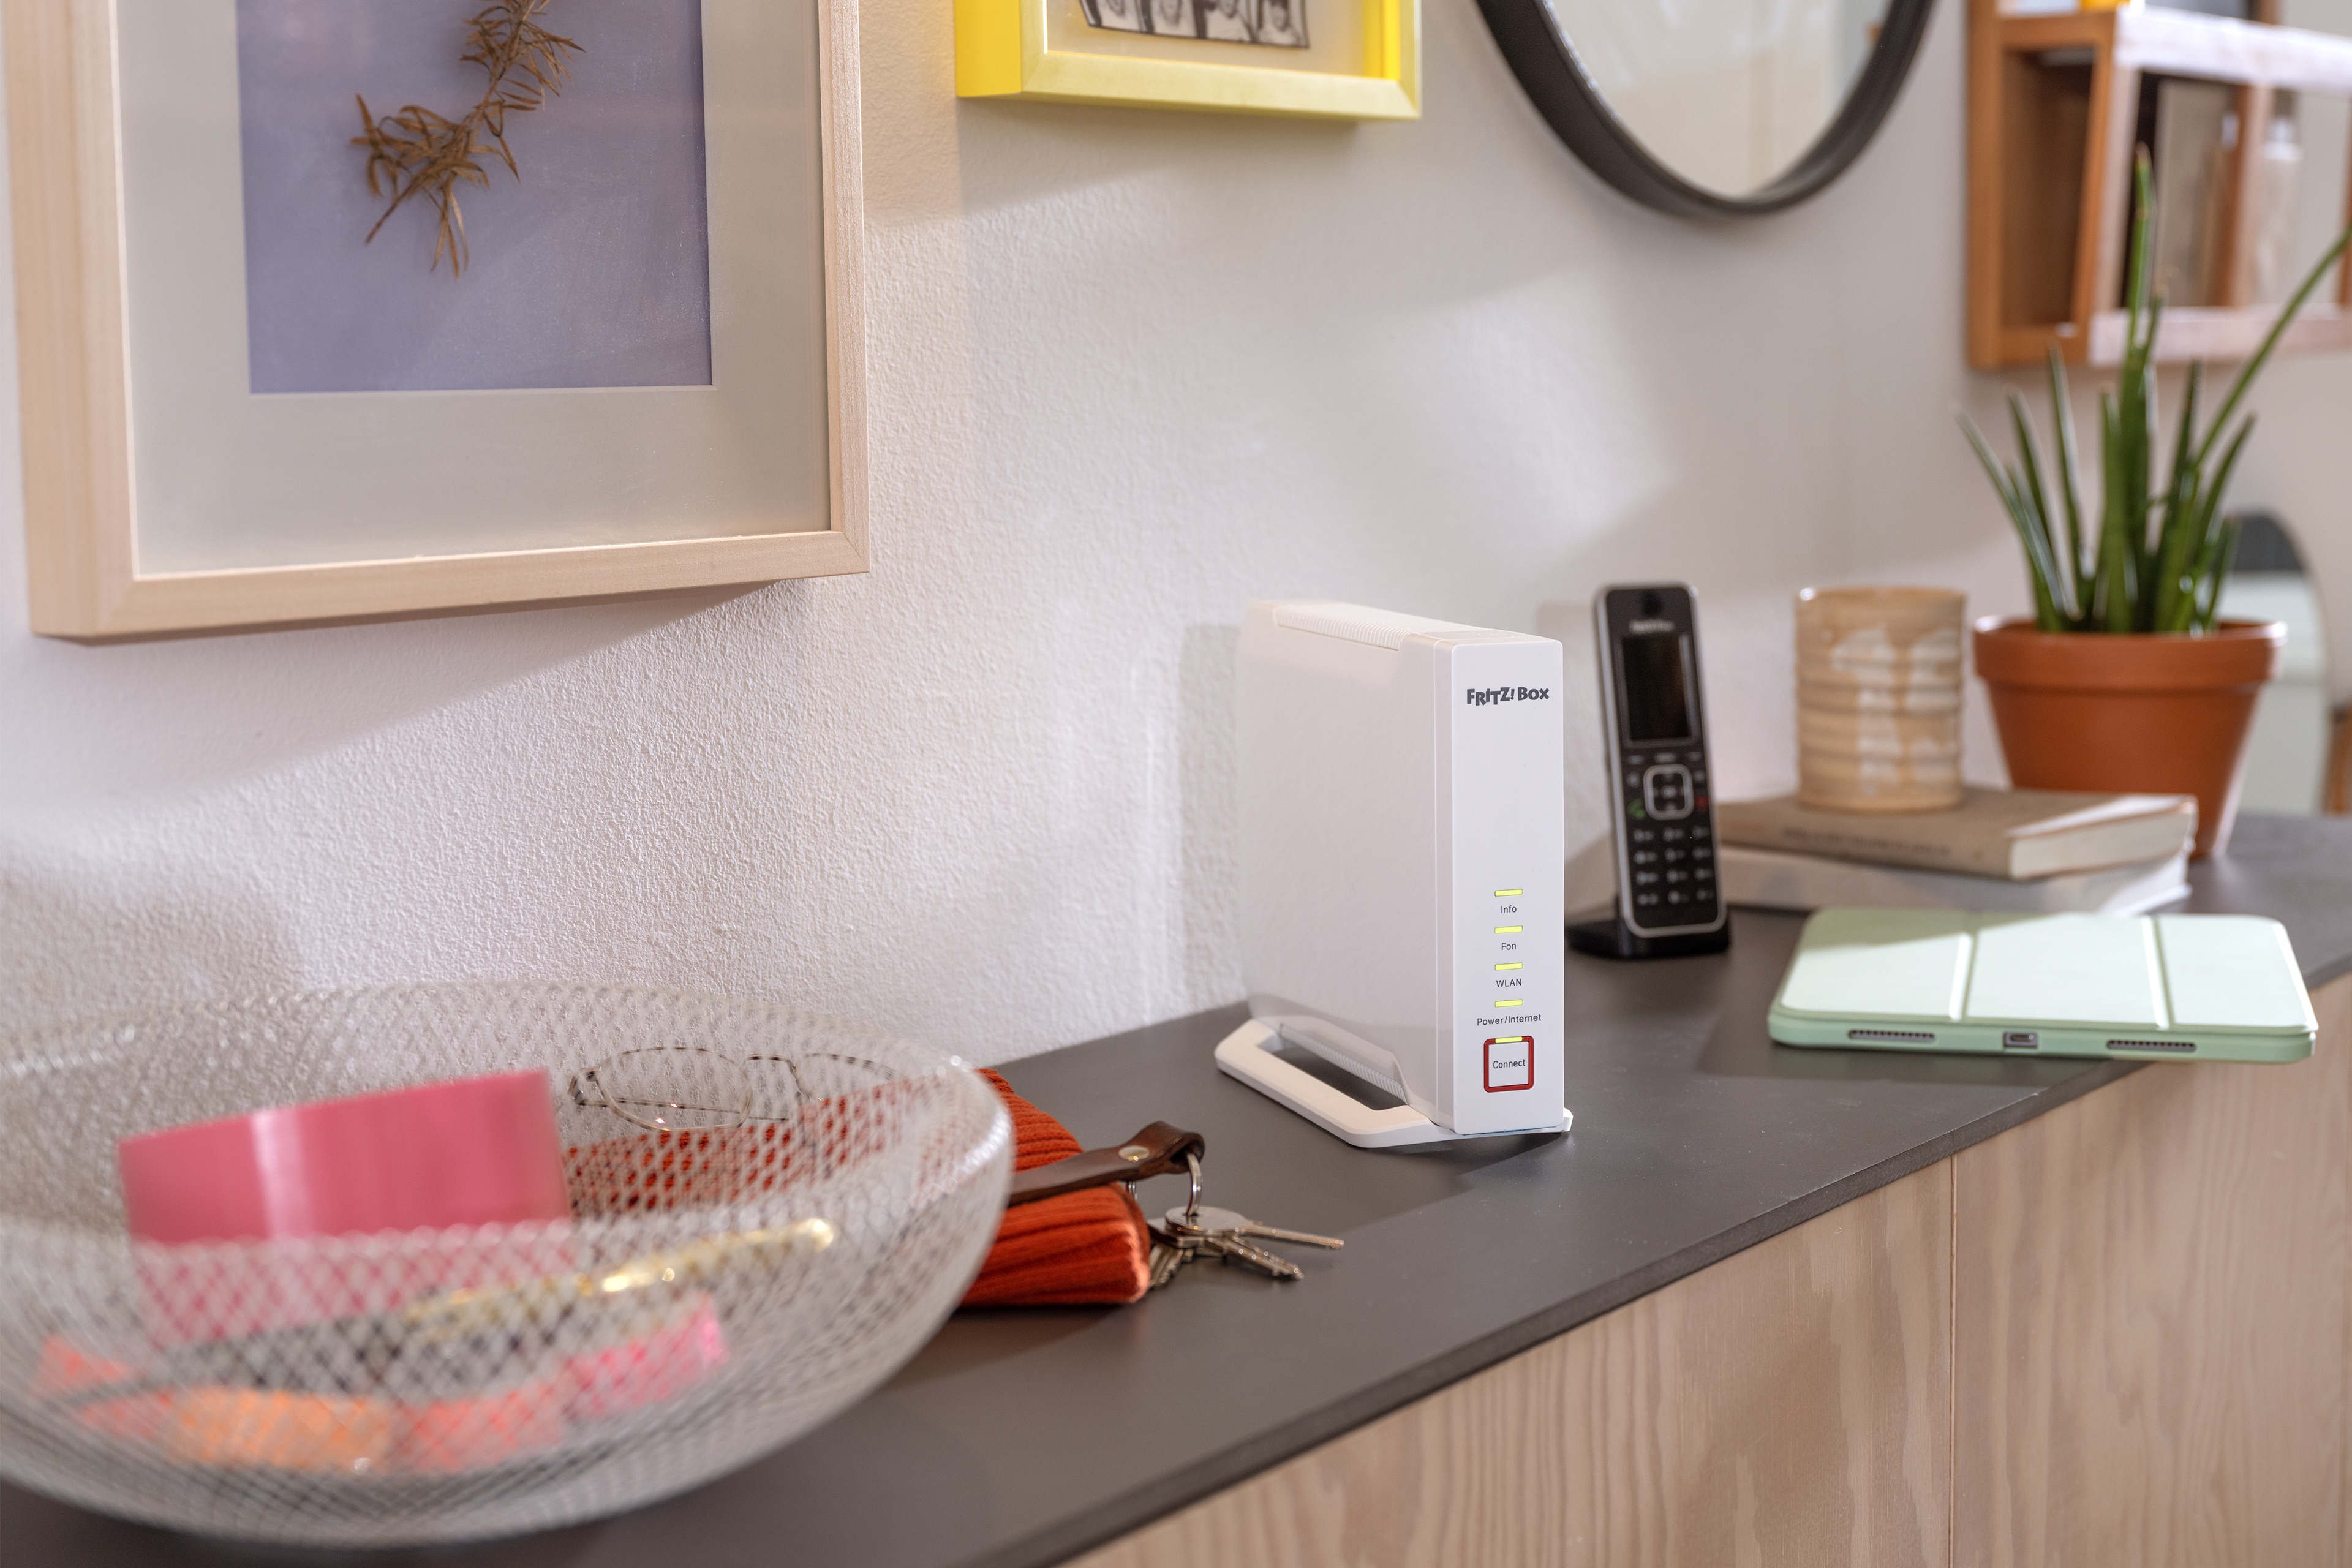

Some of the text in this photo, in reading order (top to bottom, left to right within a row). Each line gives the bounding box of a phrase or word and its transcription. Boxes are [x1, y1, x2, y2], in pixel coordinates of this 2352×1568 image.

[1501, 905, 1517, 914] Info
[1501, 942, 1517, 951] Fon
[1496, 978, 1522, 988] WLAN
[1477, 1014, 1542, 1026] Power/Internet
[1493, 1058, 1526, 1069] Connect
